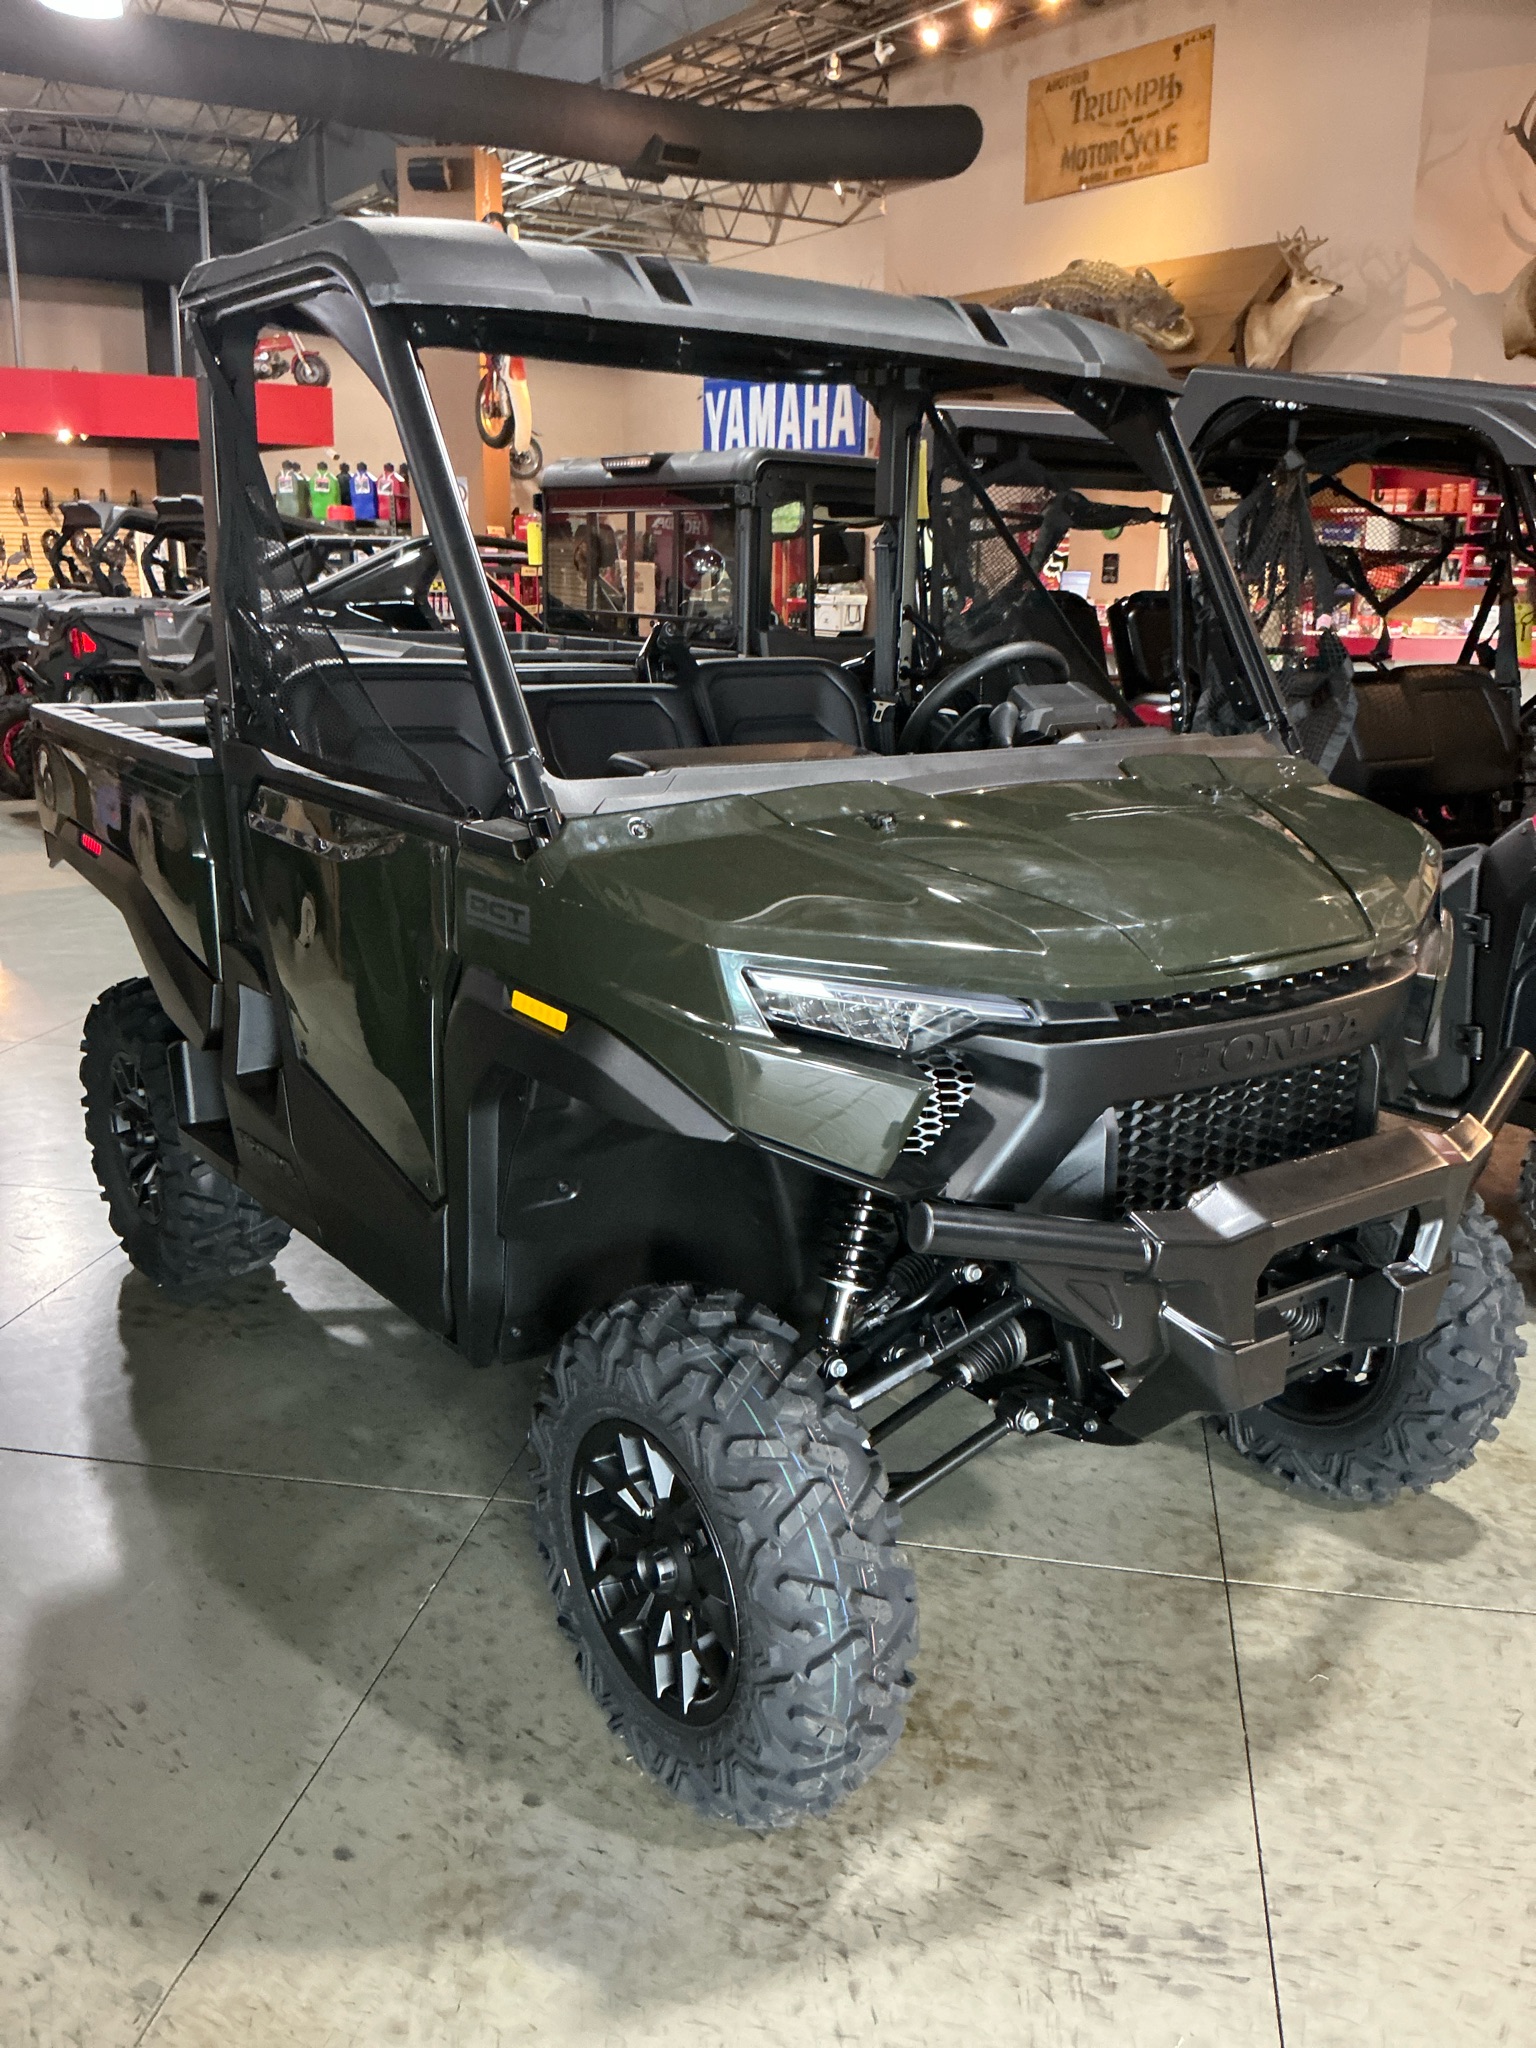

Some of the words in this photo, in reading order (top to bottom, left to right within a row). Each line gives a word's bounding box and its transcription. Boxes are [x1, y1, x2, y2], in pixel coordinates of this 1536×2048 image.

[1070, 72, 1183, 125] TRIUMPH
[705, 383, 856, 451] YAMAHA
[1173, 1008, 1365, 1078] HONDA
